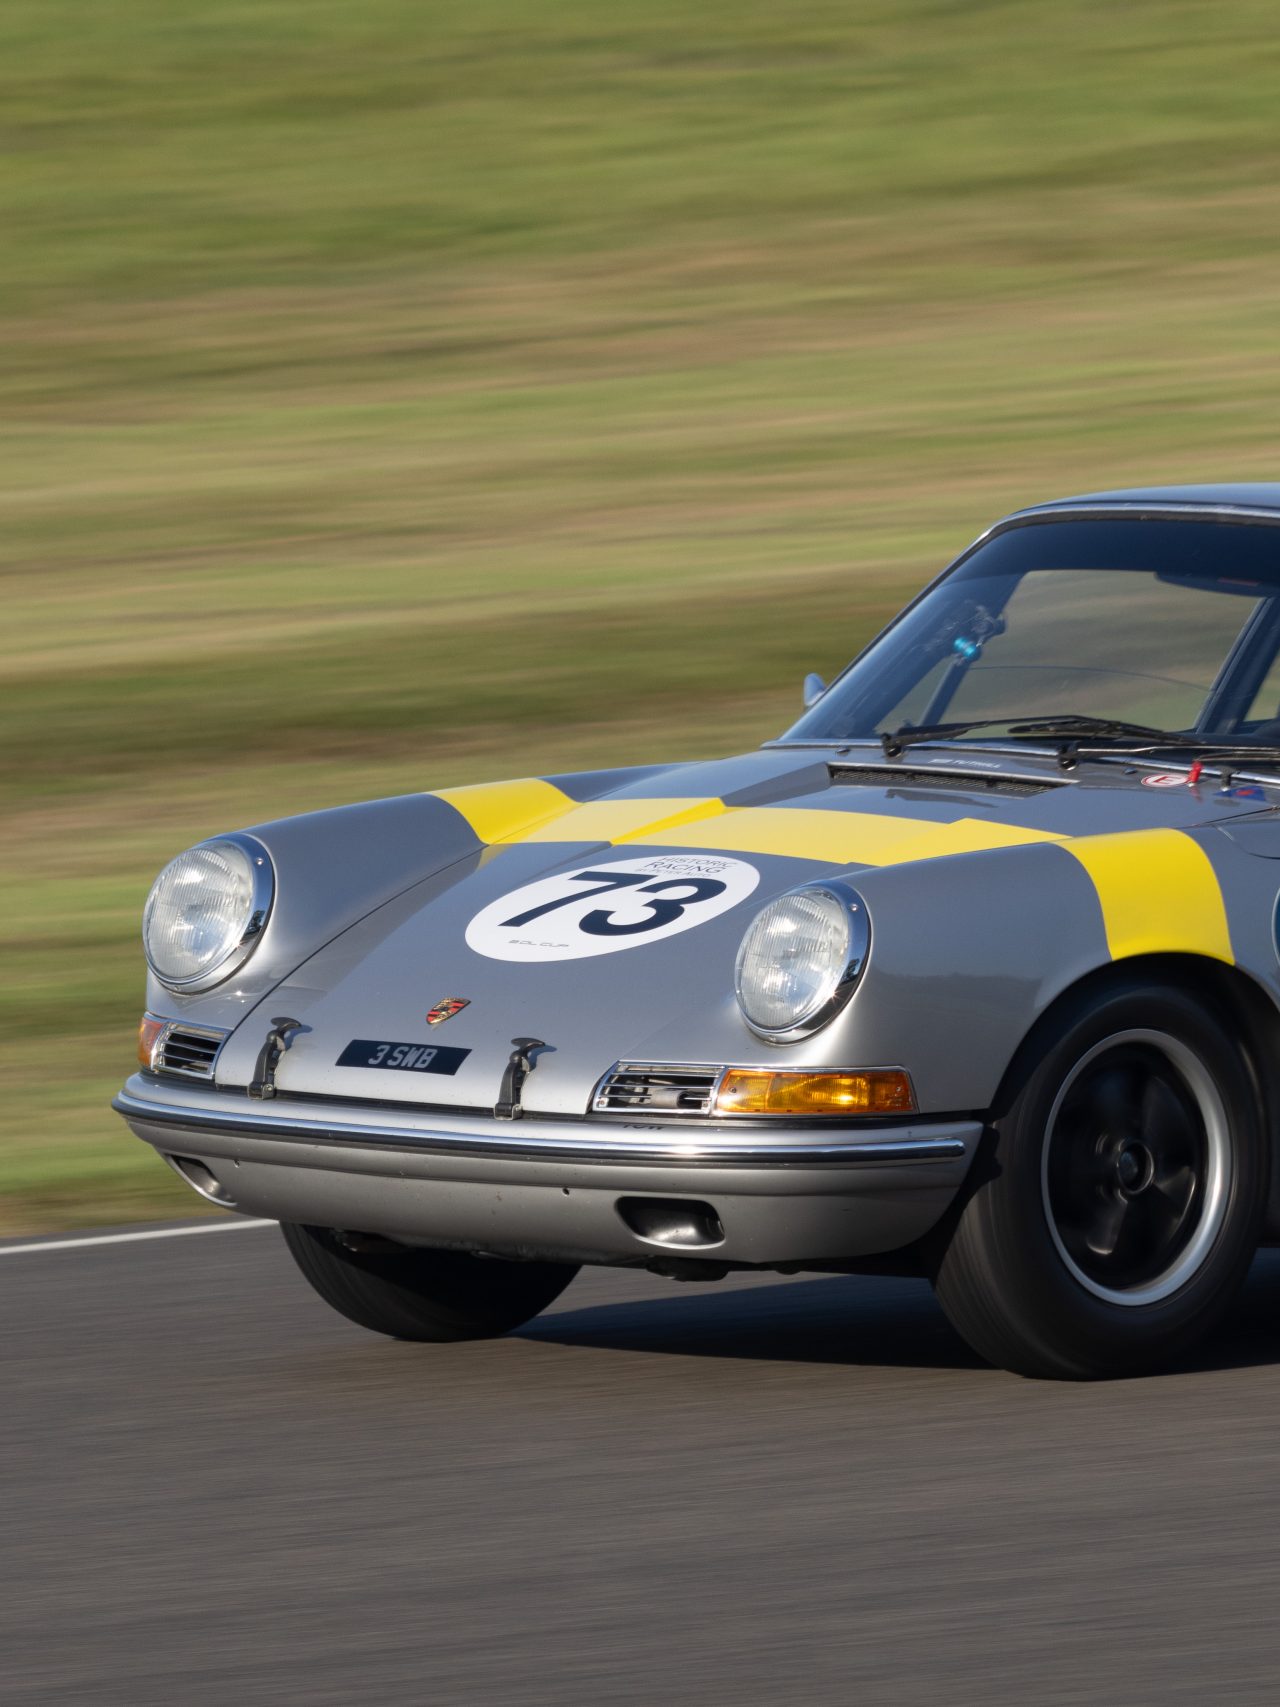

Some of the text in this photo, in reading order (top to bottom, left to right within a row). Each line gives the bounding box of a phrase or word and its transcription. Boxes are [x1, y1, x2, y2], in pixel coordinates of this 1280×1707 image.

[644, 861, 726, 874] RACING
[497, 871, 727, 936] 73
[368, 1044, 438, 1069] 3 SWB
